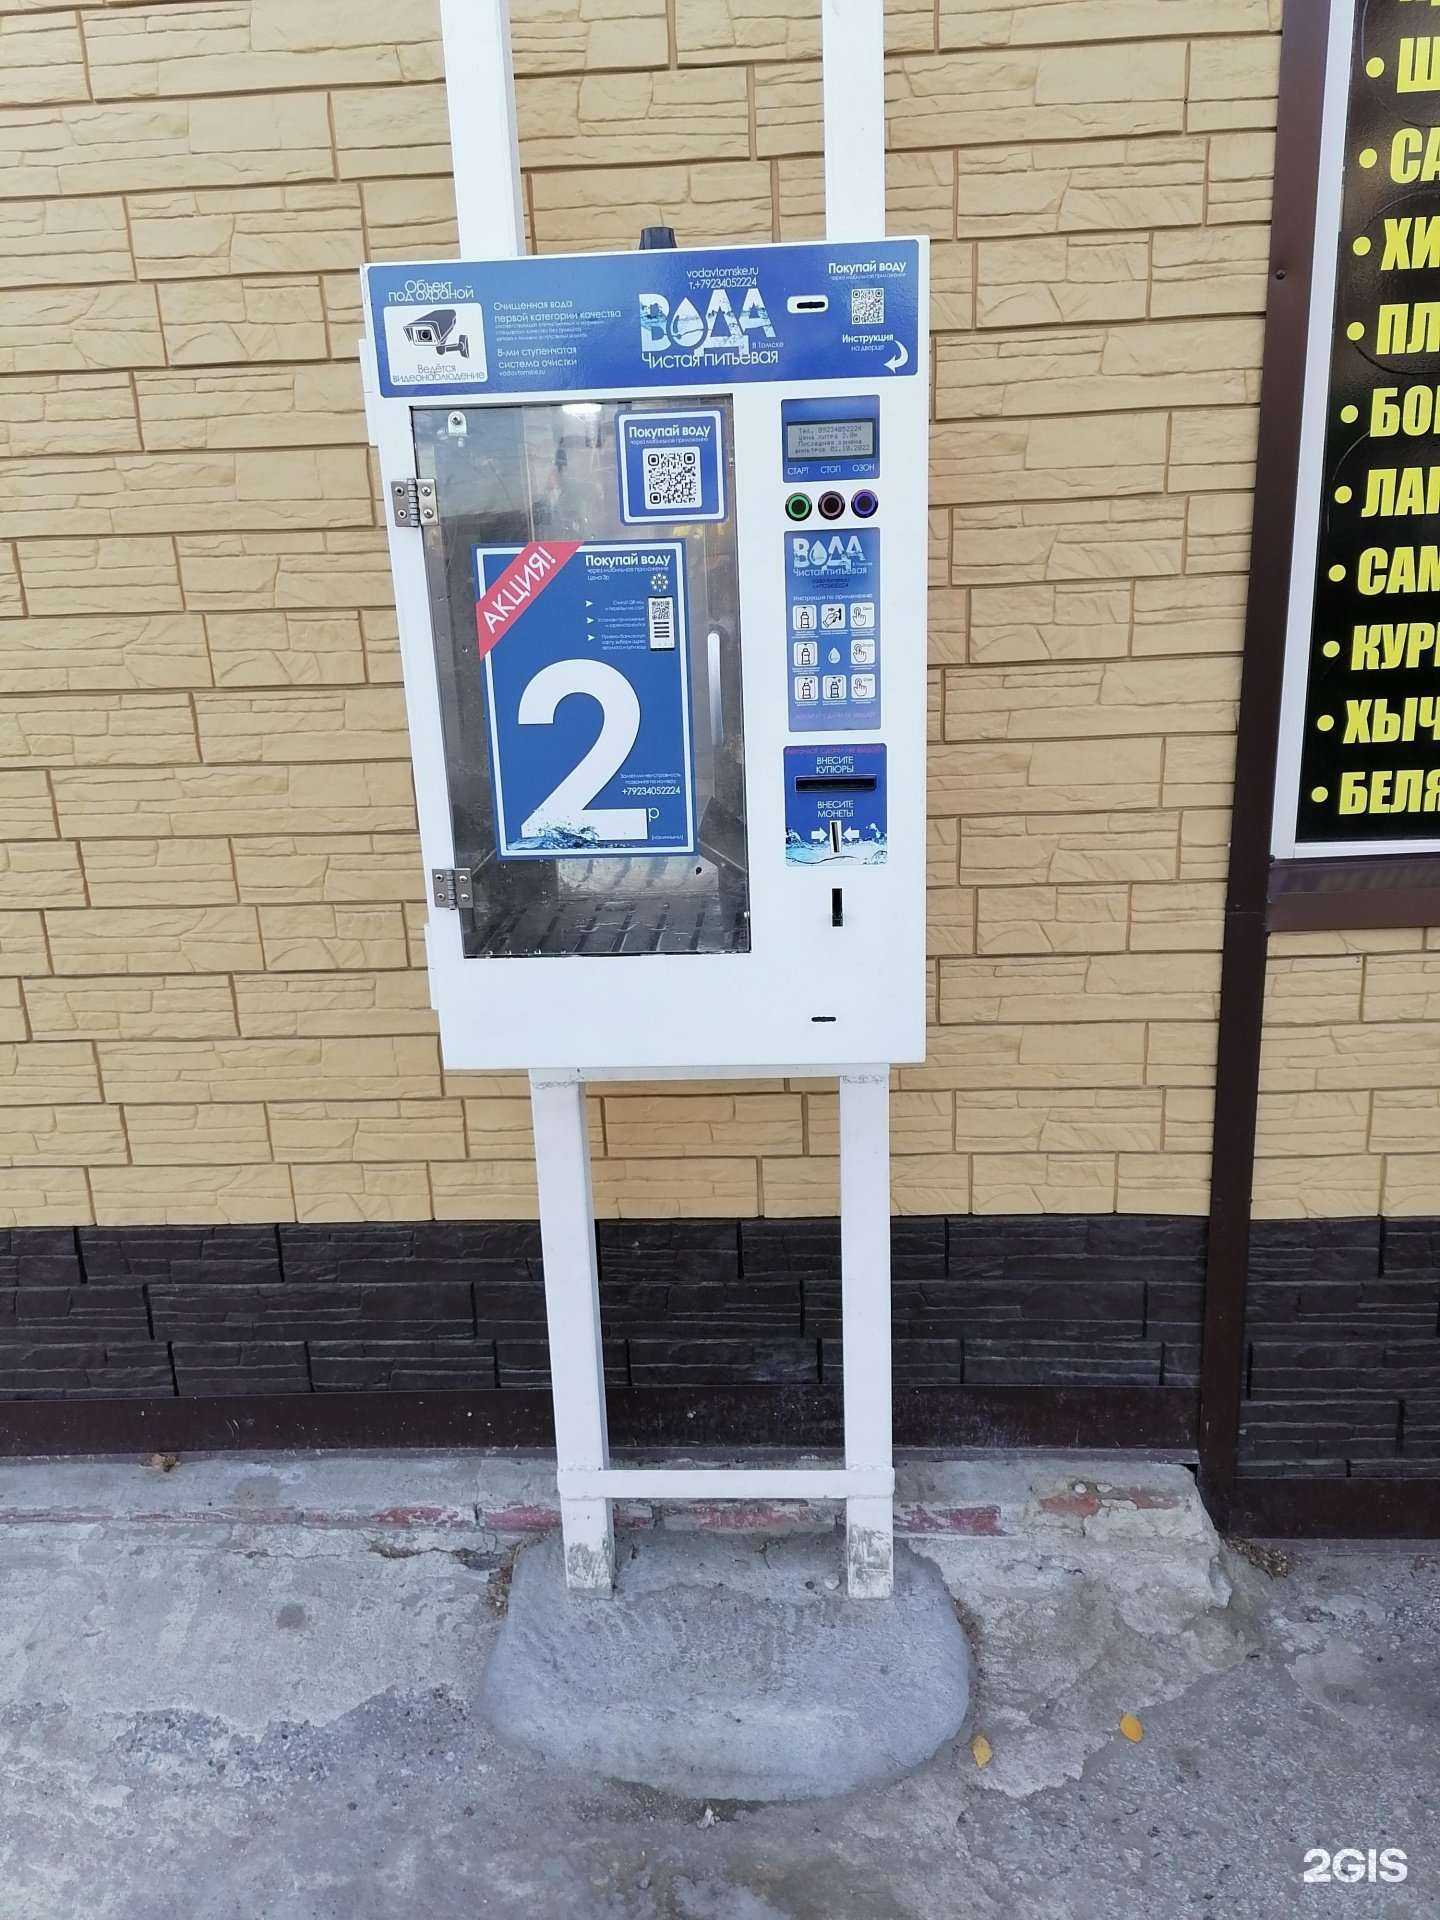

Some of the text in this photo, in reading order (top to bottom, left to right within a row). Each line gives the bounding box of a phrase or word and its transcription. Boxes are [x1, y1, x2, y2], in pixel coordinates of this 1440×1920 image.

[687, 266, 758, 278] vodavtomske.ru
[828, 260, 906, 275] Покупай воду
[404, 280, 453, 294] Объект
[388, 285, 475, 302] под охраной
[493, 300, 573, 311] Очищенная вода
[494, 312, 529, 324] первой
[530, 312, 578, 322] категории
[580, 310, 622, 320] качества
[842, 333, 894, 344] Инструкция
[521, 346, 577, 358] ступенчатая
[498, 359, 577, 369] система очистки
[641, 350, 779, 368] Чистая питьевая
[392, 371, 486, 383] видеонаблюдение
[1370, 384, 1440, 438] БО
[629, 424, 711, 439] Покупай воду
[820, 464, 841, 474] СТОП
[852, 463, 875, 472] ОЗОН
[585, 552, 671, 568] Покупай воду
[482, 546, 558, 634] АКЦИЯ!
[1351, 622, 1440, 671] КУР
[518, 658, 648, 841] 2
[816, 756, 854, 765] ВНЕСИТЕ
[816, 765, 854, 774] КУПЮРЫ
[621, 786, 681, 796] +79234052224
[817, 800, 854, 809] ВНЕСИТЕ
[817, 809, 854, 818] МОНЕТЫ
